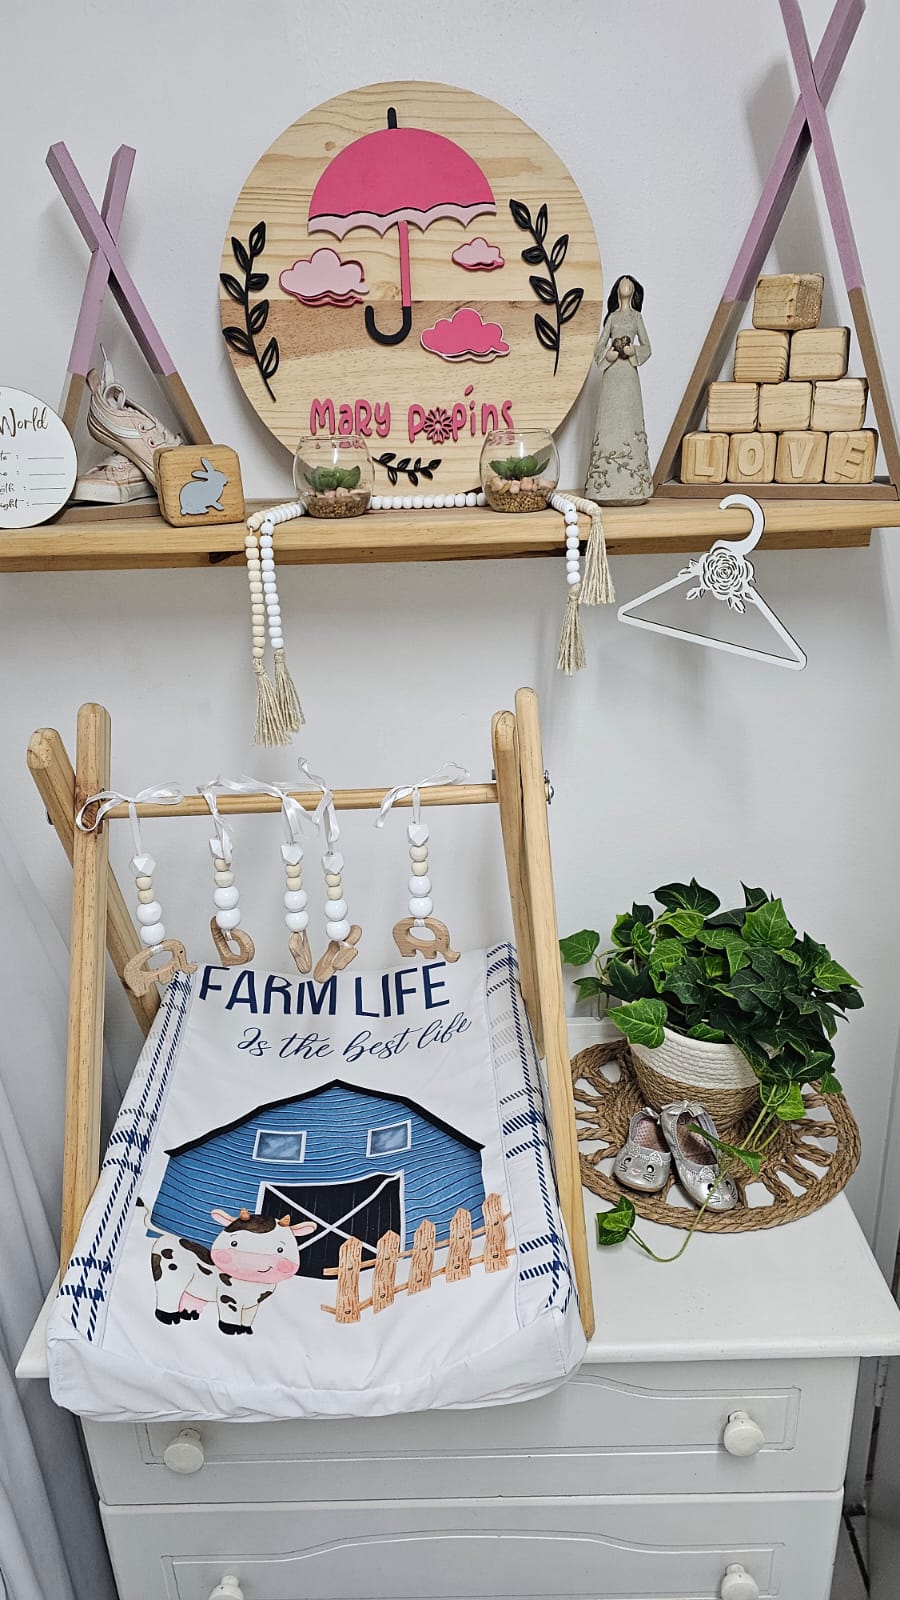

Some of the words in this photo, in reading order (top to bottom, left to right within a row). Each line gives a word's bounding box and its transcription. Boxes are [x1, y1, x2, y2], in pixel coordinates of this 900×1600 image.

[0, 406, 48, 438] World
[694, 438, 869, 480] LOVE
[199, 965, 337, 1016] FARM
[354, 961, 450, 1018] LIFE
[279, 1032, 334, 1060] the
[342, 1030, 423, 1063] best
[416, 1011, 473, 1050] life
